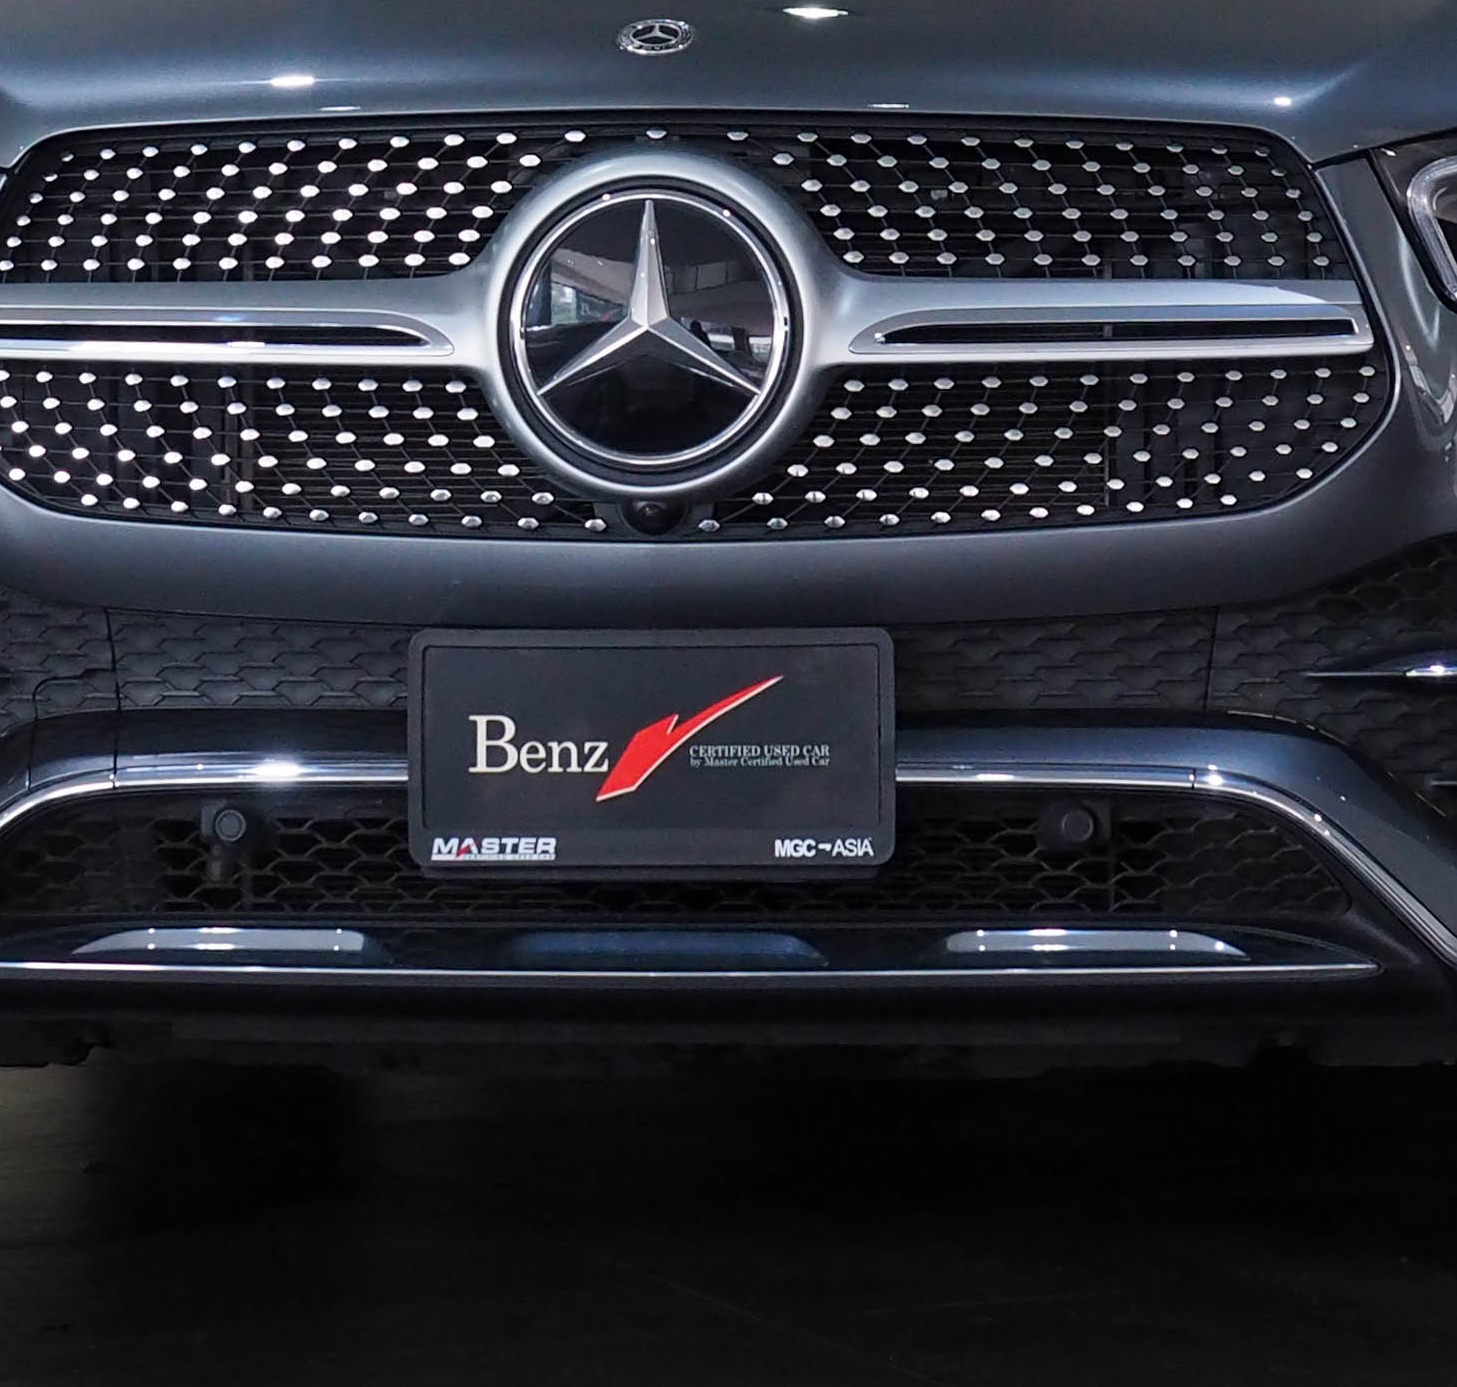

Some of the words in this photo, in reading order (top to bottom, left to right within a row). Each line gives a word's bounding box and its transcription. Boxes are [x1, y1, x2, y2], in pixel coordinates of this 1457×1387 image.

[469, 715, 609, 773] Benz
[690, 744, 761, 757] CERTIFIED
[763, 744, 800, 757] USED
[802, 744, 830, 757] CAR
[704, 756, 738, 767] Master
[740, 756, 783, 767] Certified
[786, 756, 810, 767] Used
[811, 756, 830, 767] Car
[432, 837, 557, 855] MASTER
